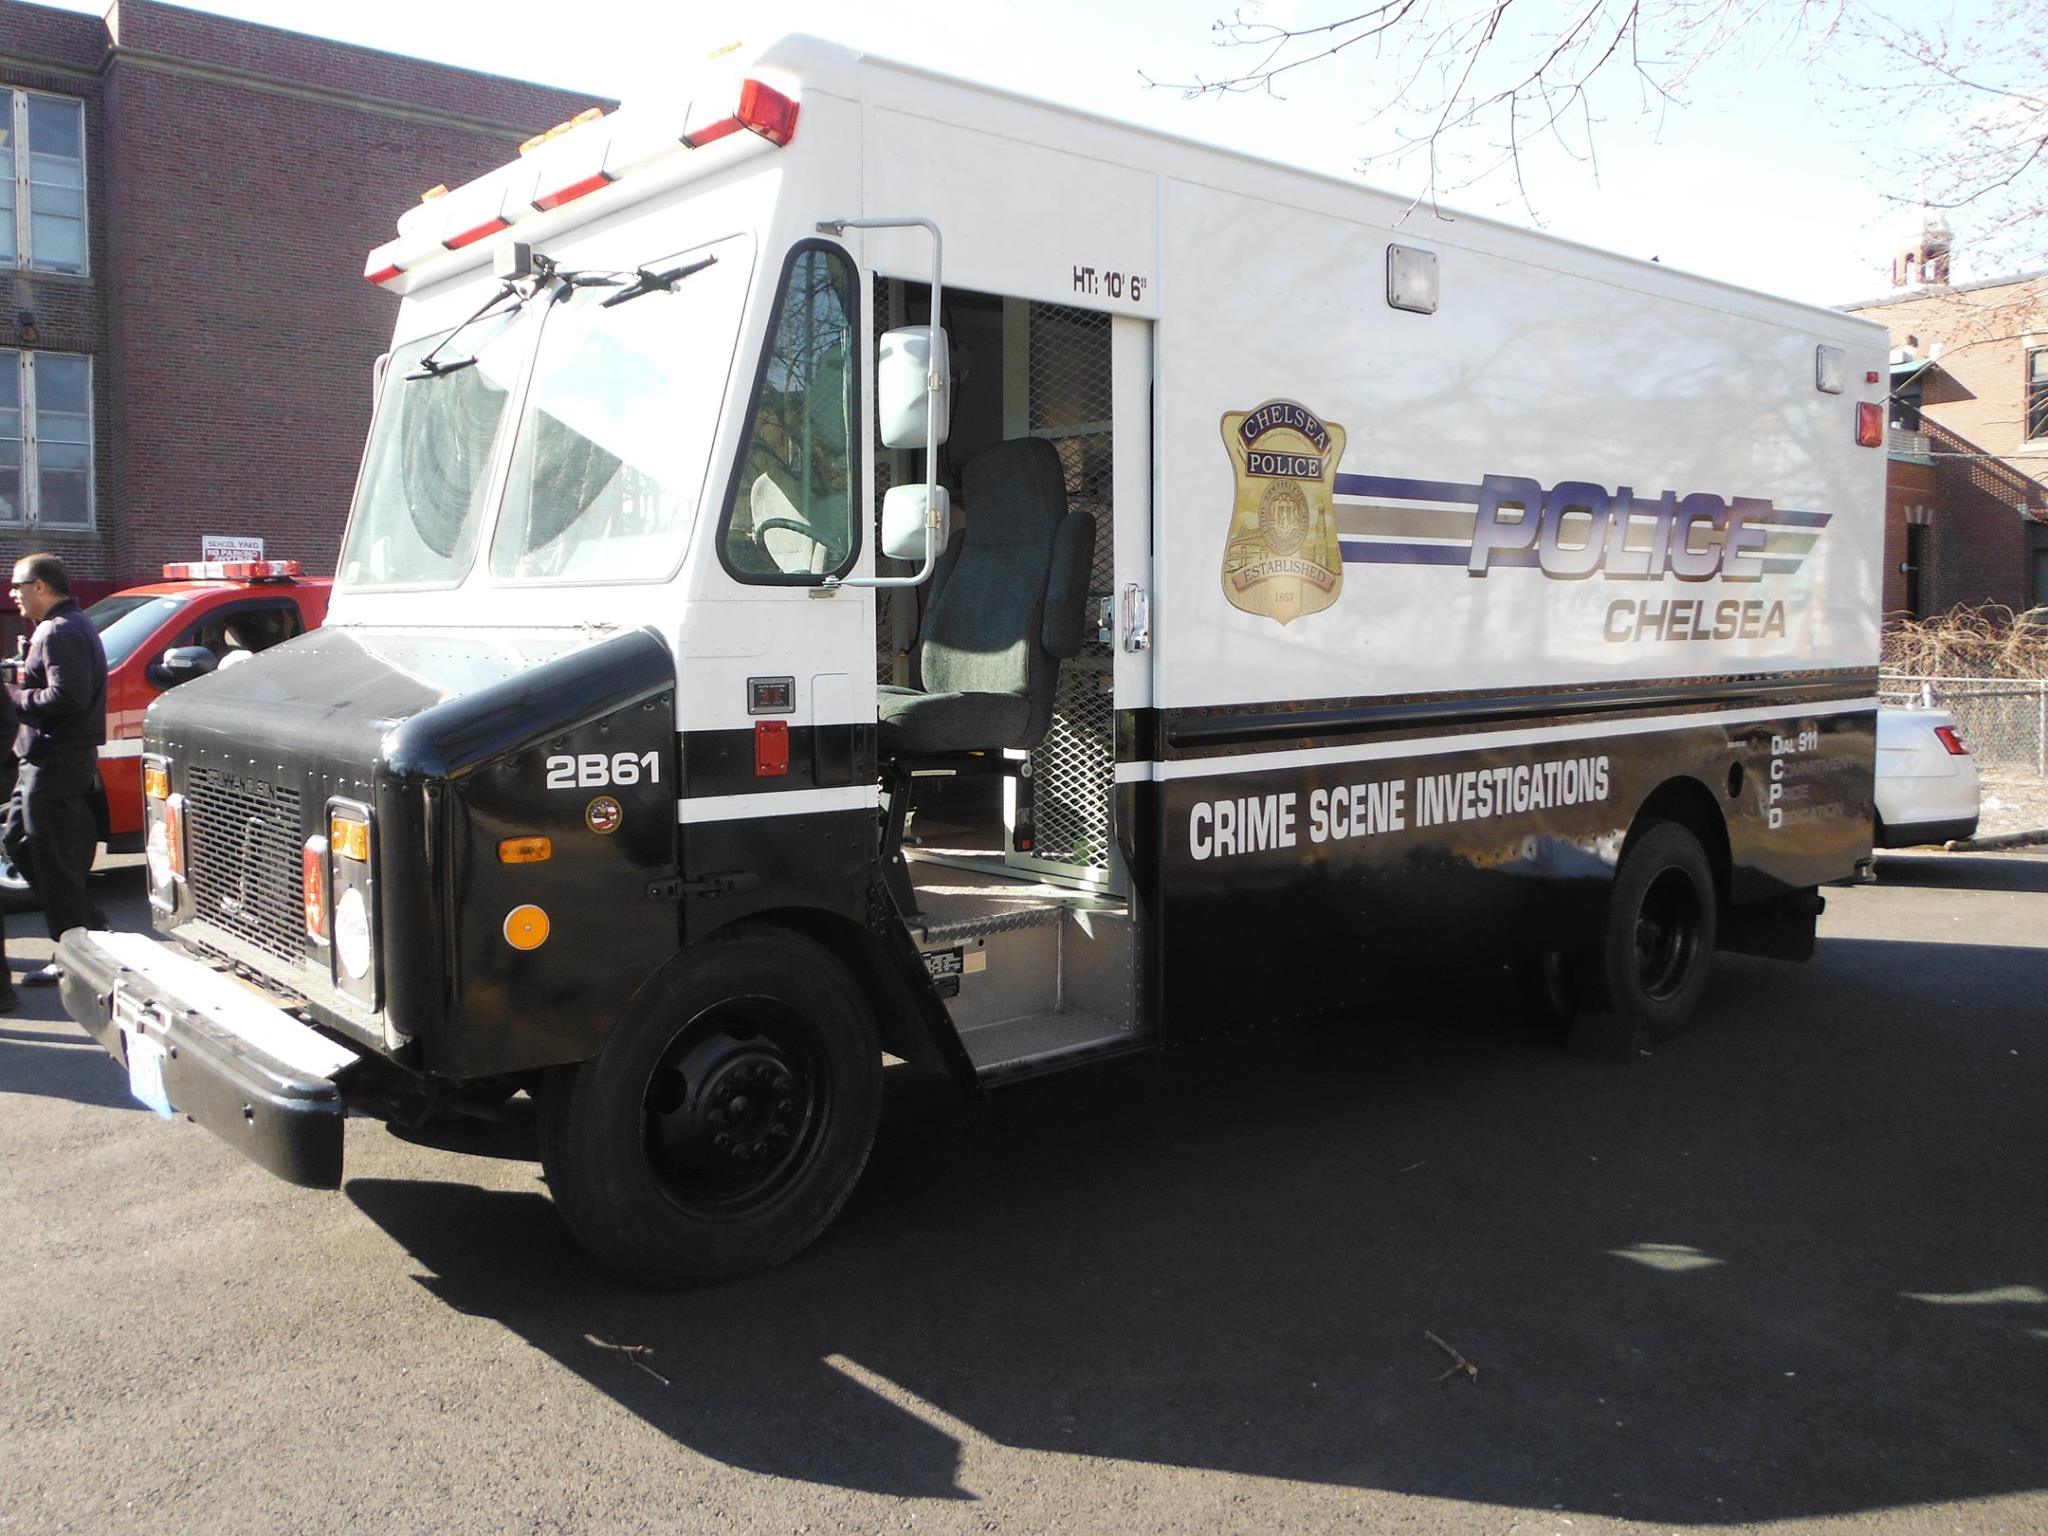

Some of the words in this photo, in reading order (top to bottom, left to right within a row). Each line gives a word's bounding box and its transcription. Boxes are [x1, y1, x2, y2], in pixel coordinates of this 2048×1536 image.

[1073, 265, 1098, 295] HT:
[1104, 271, 1125, 298] 10'
[1244, 405, 1326, 450] CHELSEA
[1249, 454, 1319, 477] POLICE
[207, 540, 236, 548] SCHOOL
[238, 541, 259, 549] YARD
[1468, 474, 1773, 582] POLICE
[1243, 560, 1327, 583] ESTABLISHED
[1603, 599, 1786, 641] CHELSEA
[1798, 731, 1818, 752] 911
[546, 751, 660, 790] 2B61
[1189, 792, 1296, 861] CRIME
[1309, 779, 1405, 844] SCENE
[1416, 755, 1609, 827] INVESTIGATIONS
